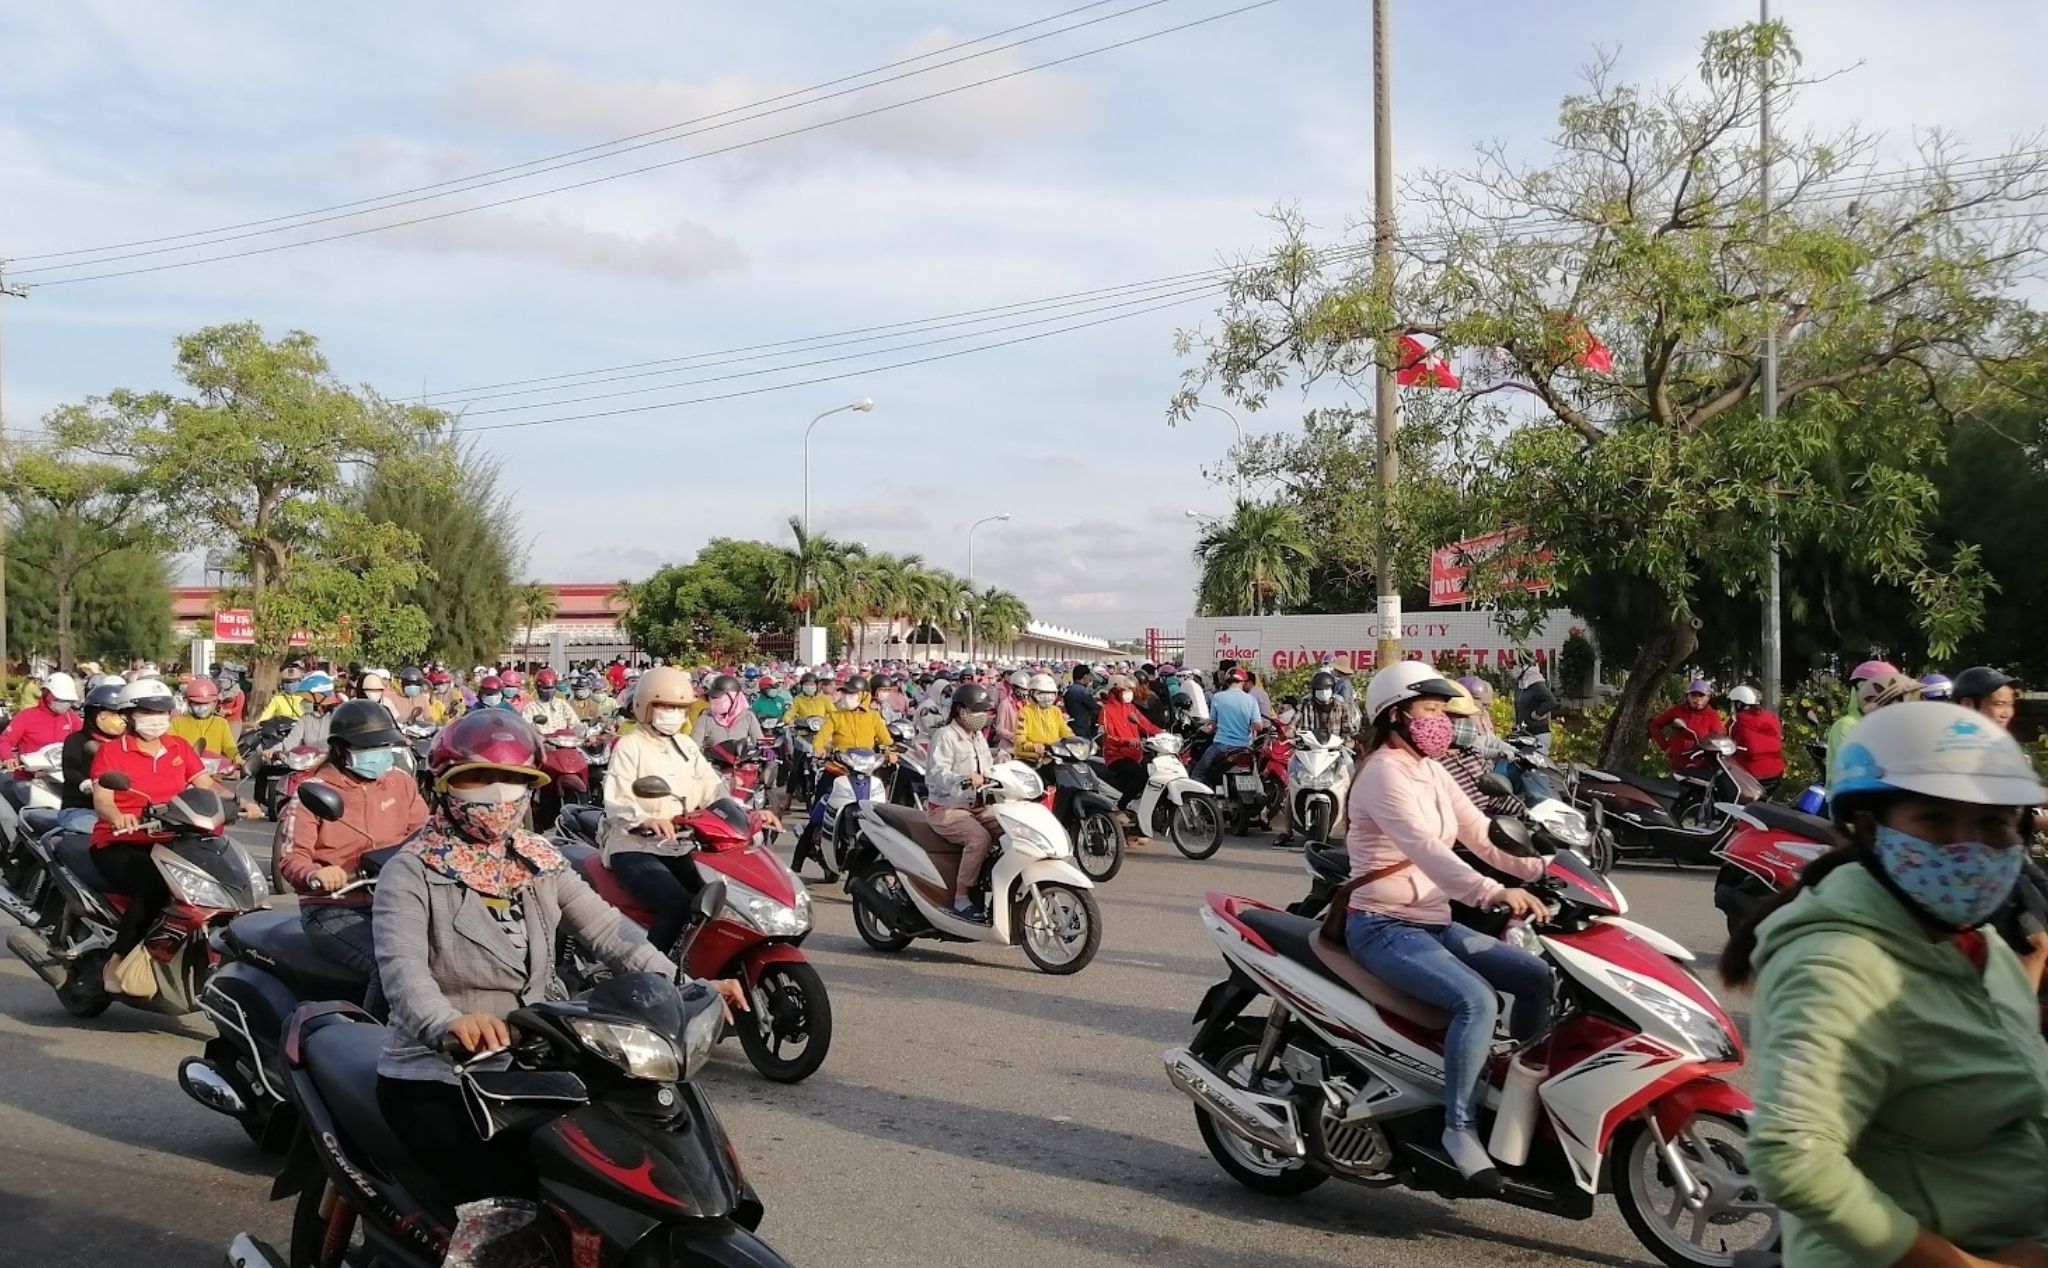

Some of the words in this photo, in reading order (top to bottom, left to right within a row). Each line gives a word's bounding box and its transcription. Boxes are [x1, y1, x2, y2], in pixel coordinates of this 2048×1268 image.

[1424, 623, 1450, 637] TY
[1215, 645, 1259, 659] rieker
[1272, 644, 1326, 670] GIÀY
[1497, 648, 1556, 671] NM
